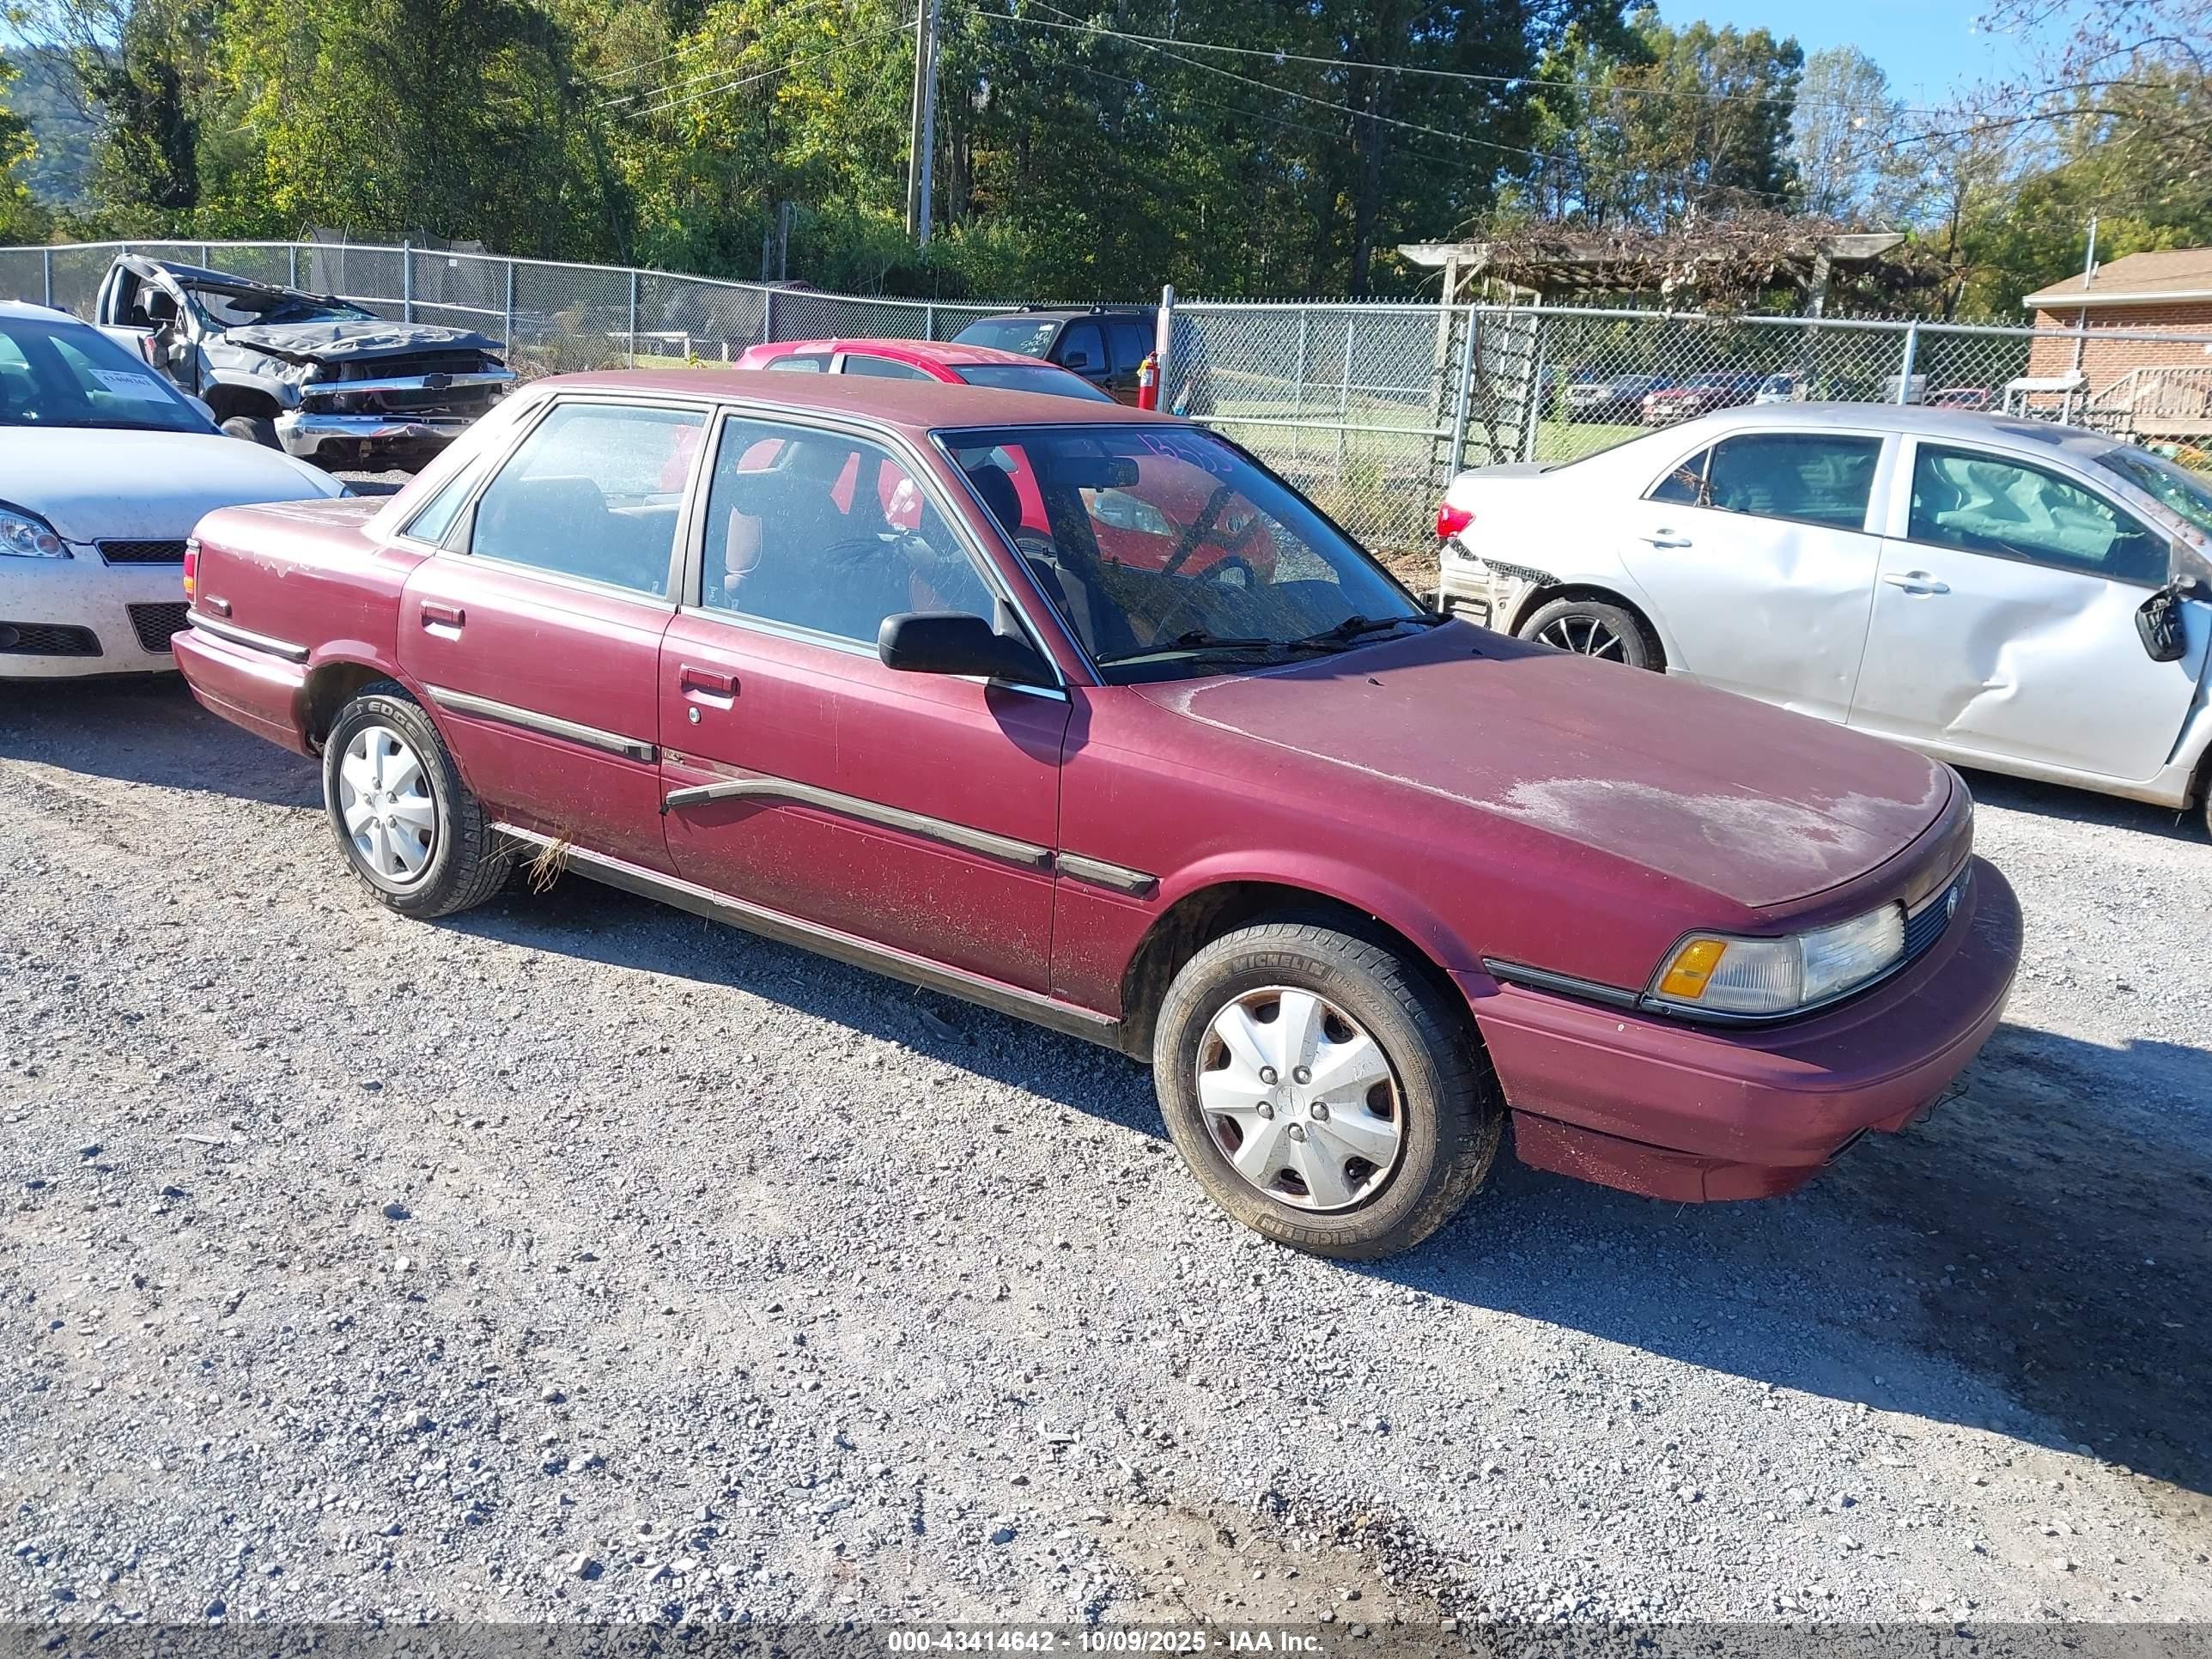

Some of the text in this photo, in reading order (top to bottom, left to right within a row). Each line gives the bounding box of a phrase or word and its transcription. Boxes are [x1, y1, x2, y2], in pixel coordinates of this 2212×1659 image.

[368, 701, 421, 740] EDGE
[1232, 953, 1326, 976] MICHELIN
[1259, 1217, 1358, 1245] MICHELIN
